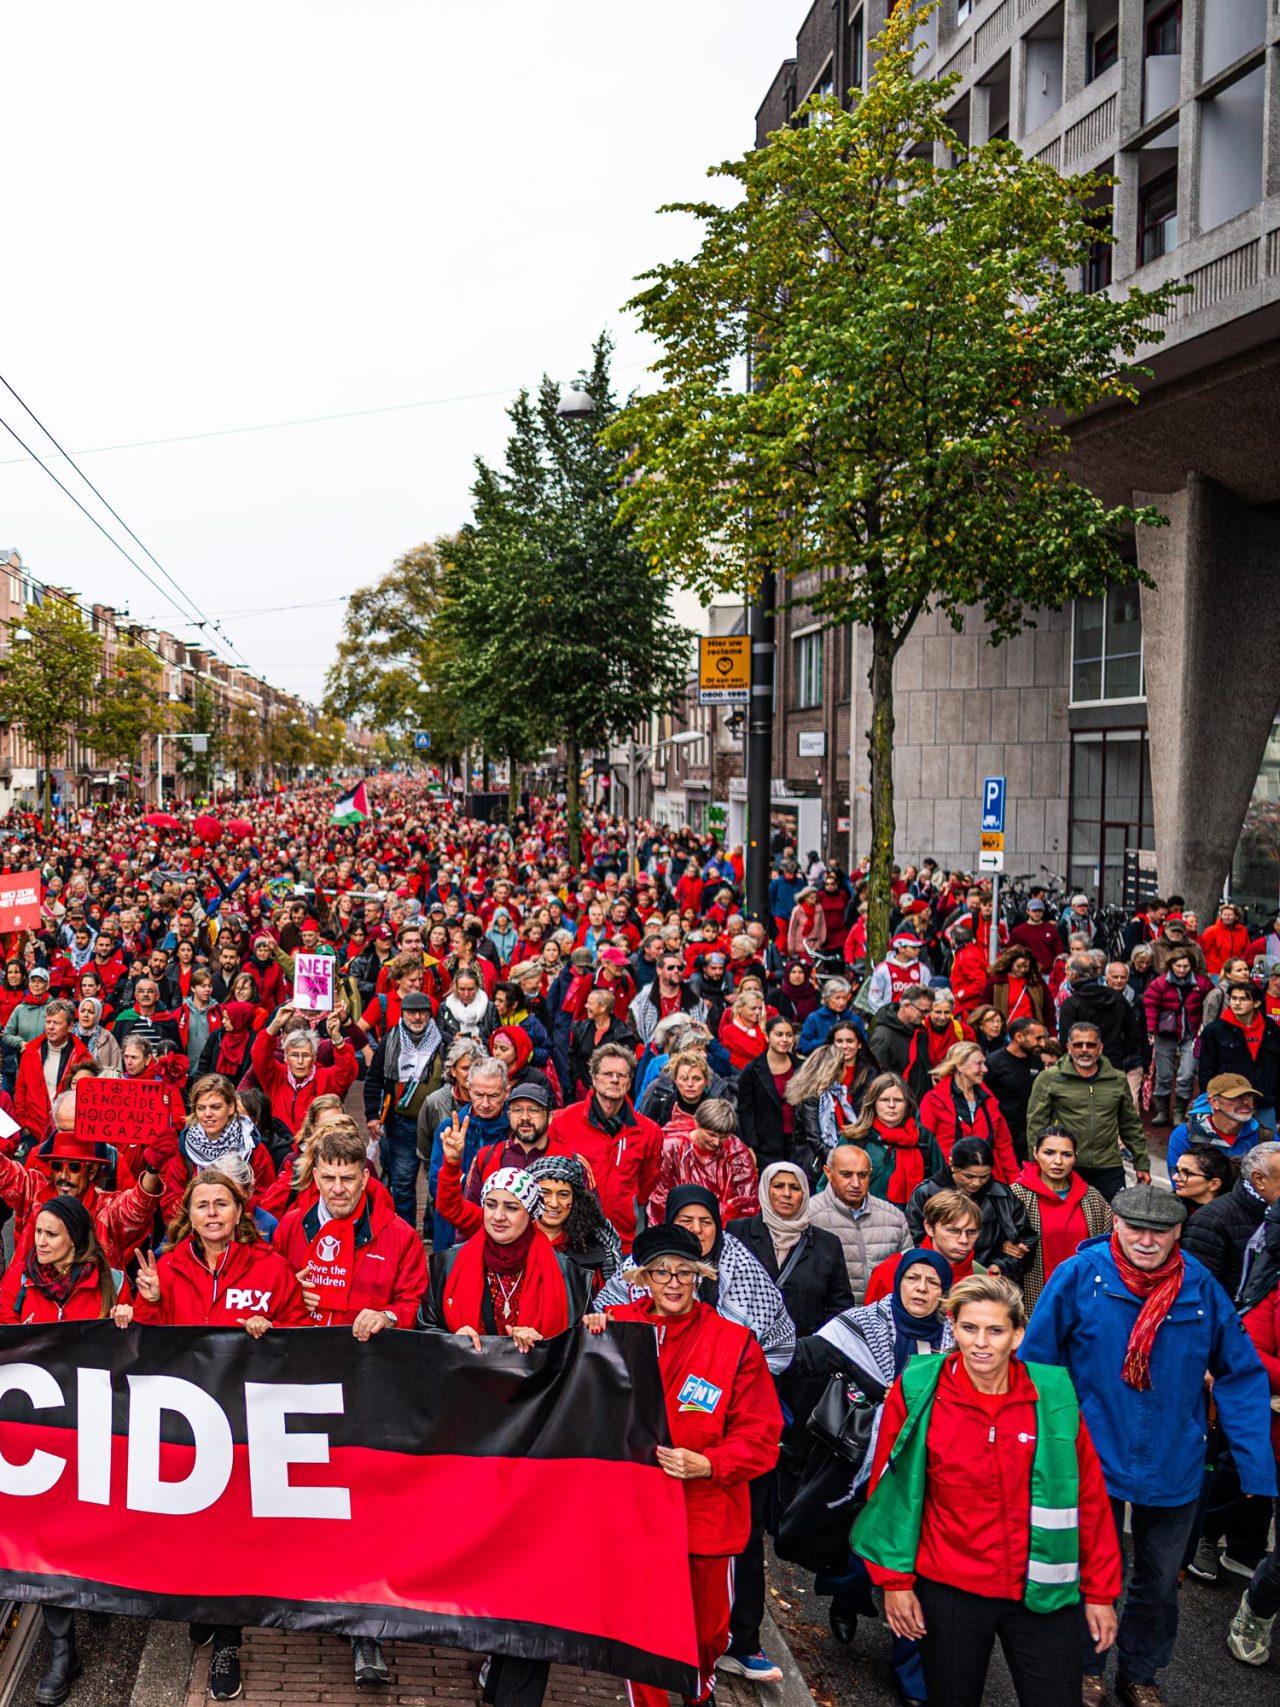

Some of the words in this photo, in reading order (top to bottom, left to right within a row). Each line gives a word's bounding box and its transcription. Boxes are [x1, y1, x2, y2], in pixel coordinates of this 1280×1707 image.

[987, 782, 999, 810] P
[0, 891, 16, 901] WIJ
[16, 888, 35, 897] ZIJN
[15, 895, 37, 905] MEER
[299, 958, 331, 977] NEE
[80, 1092, 155, 1110] GENOCIDE
[78, 1108, 163, 1125] HOLOCAUST
[80, 1122, 96, 1135] IN
[102, 1124, 158, 1139] GAZA
[308, 1260, 328, 1274] Save
[330, 1265, 347, 1276] the
[225, 1288, 272, 1312] PAX
[682, 1382, 720, 1405] FNV
